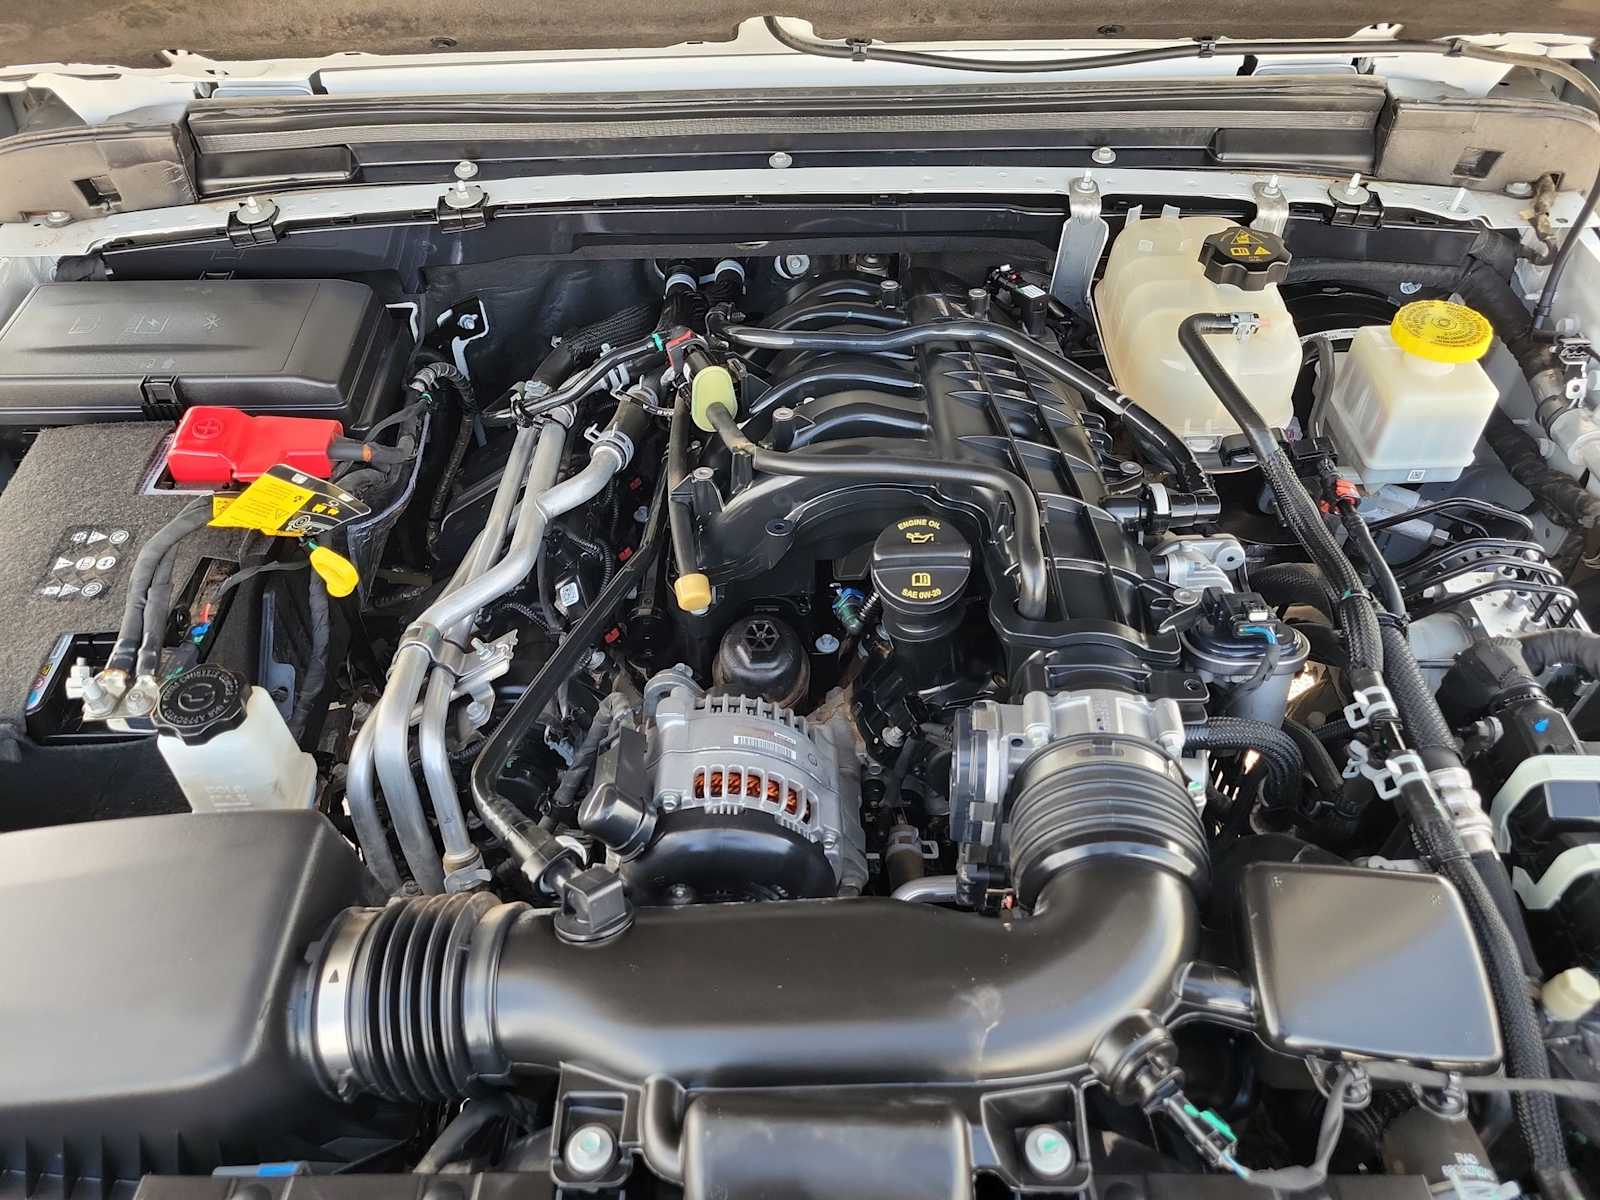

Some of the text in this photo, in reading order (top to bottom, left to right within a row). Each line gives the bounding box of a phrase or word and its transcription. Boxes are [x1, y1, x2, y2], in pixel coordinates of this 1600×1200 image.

[897, 519, 941, 530] ENGINE OIL
[901, 588, 918, 599] SAE
